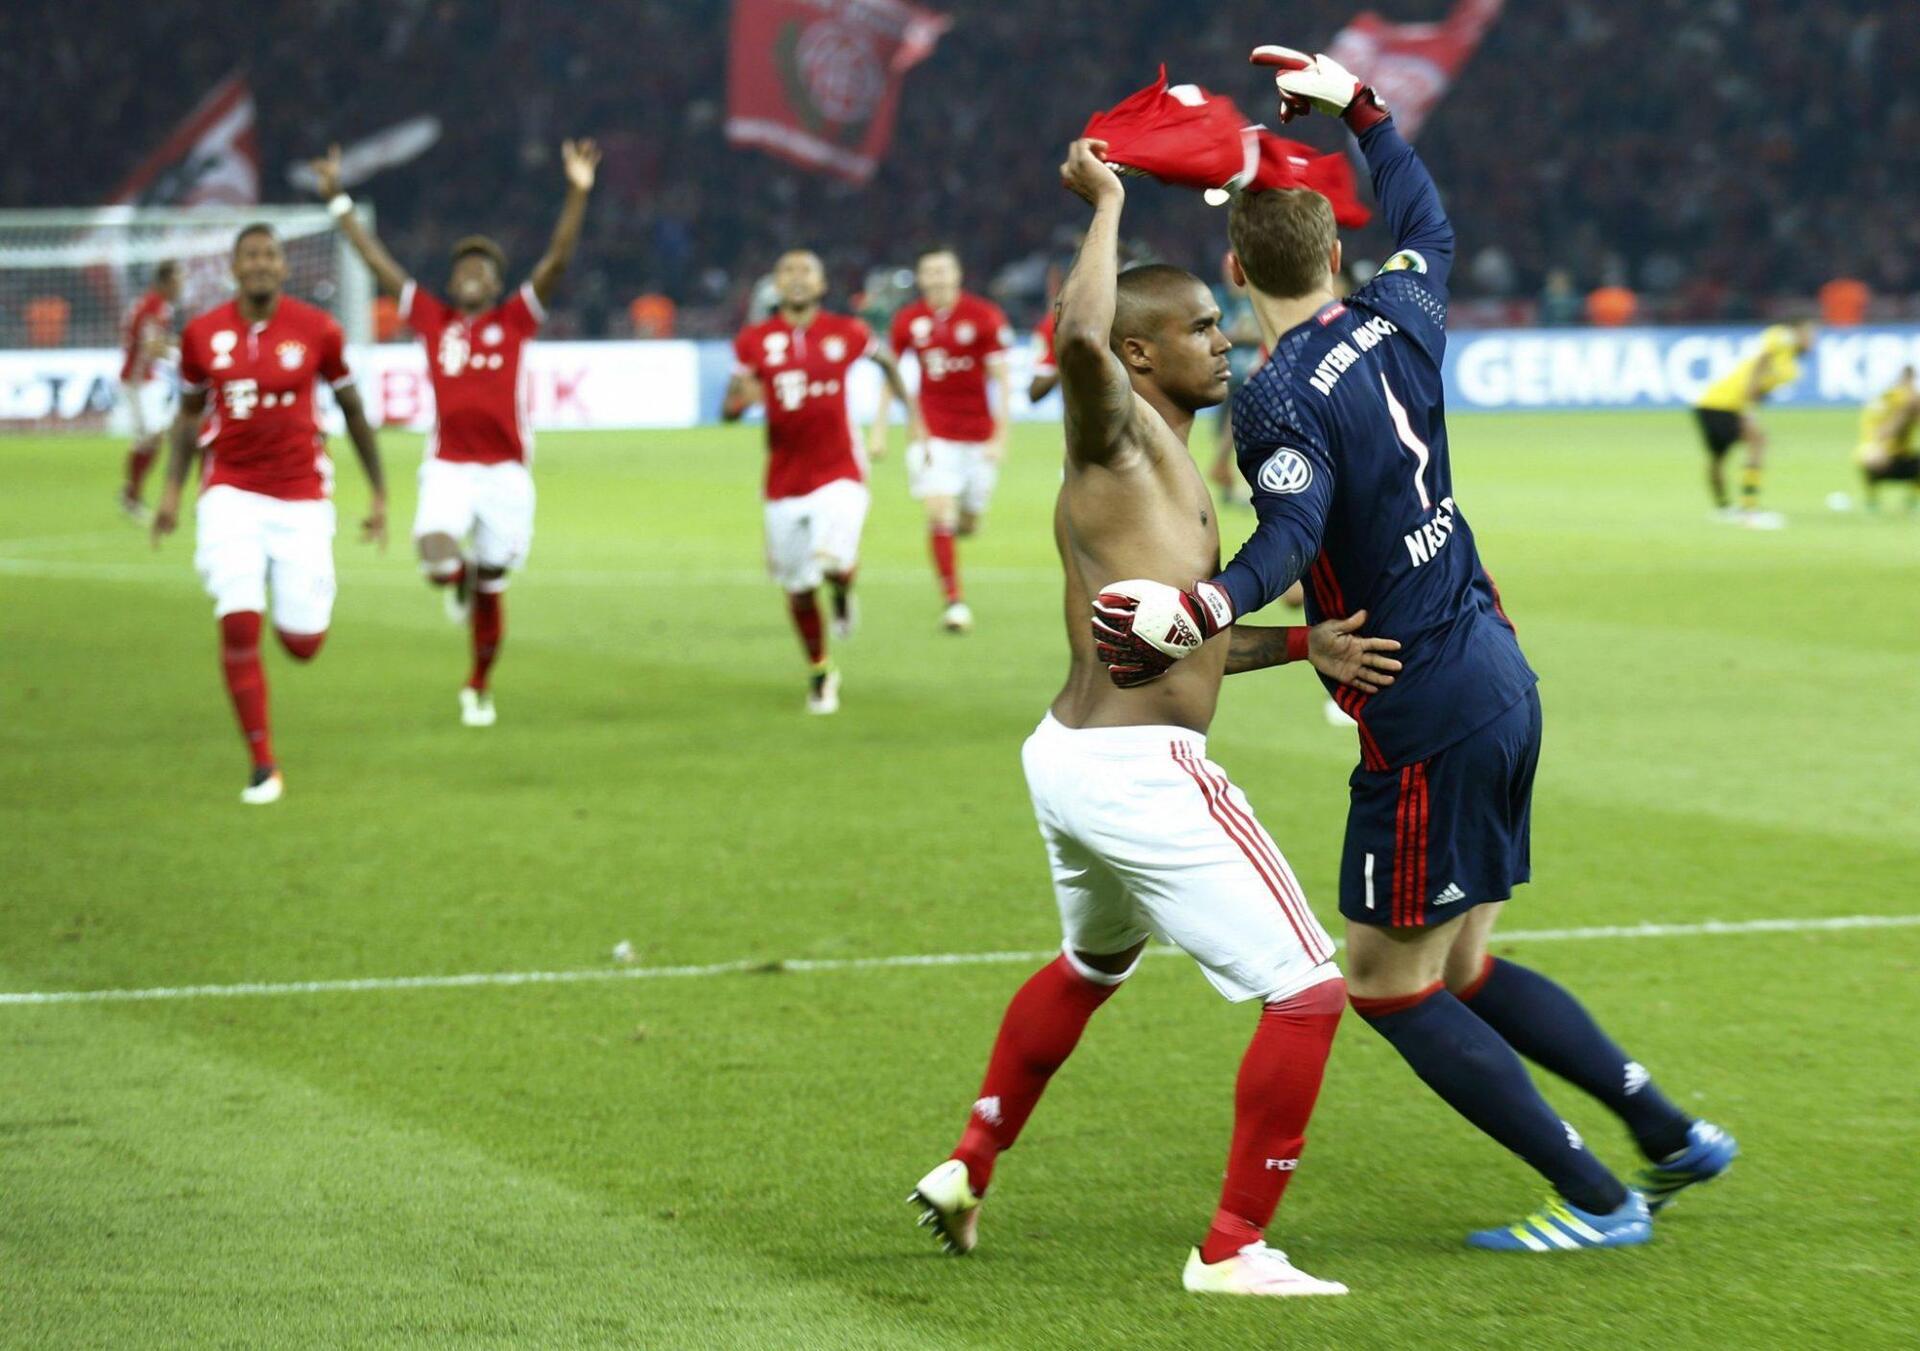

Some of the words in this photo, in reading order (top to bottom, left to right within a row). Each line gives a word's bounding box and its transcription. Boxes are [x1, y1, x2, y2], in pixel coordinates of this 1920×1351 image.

[1380, 372, 1431, 512] 1
[1174, 614, 1198, 646] adidas
[1364, 853, 1375, 910] 1
